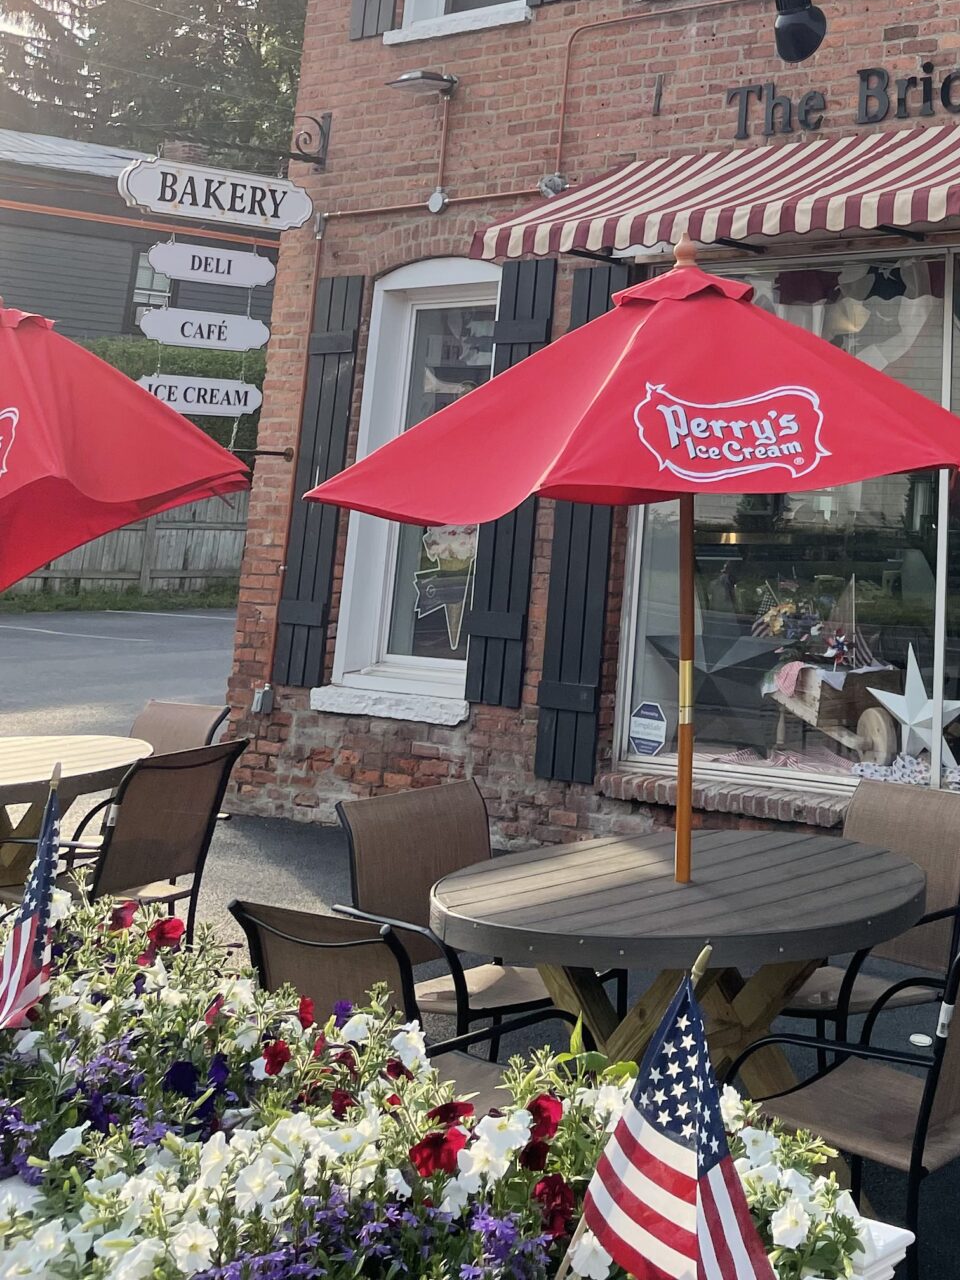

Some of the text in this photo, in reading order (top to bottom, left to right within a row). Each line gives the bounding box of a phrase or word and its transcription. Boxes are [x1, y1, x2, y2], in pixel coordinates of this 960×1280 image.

[726, 82, 826, 139] The
[157, 171, 288, 219] BAKERY
[190, 254, 233, 275] DELI
[180, 320, 228, 341] CAFÉ
[183, 386, 249, 407] CREAM
[657, 404, 800, 449] Perry's
[685, 437, 802, 462] Ice Cream
